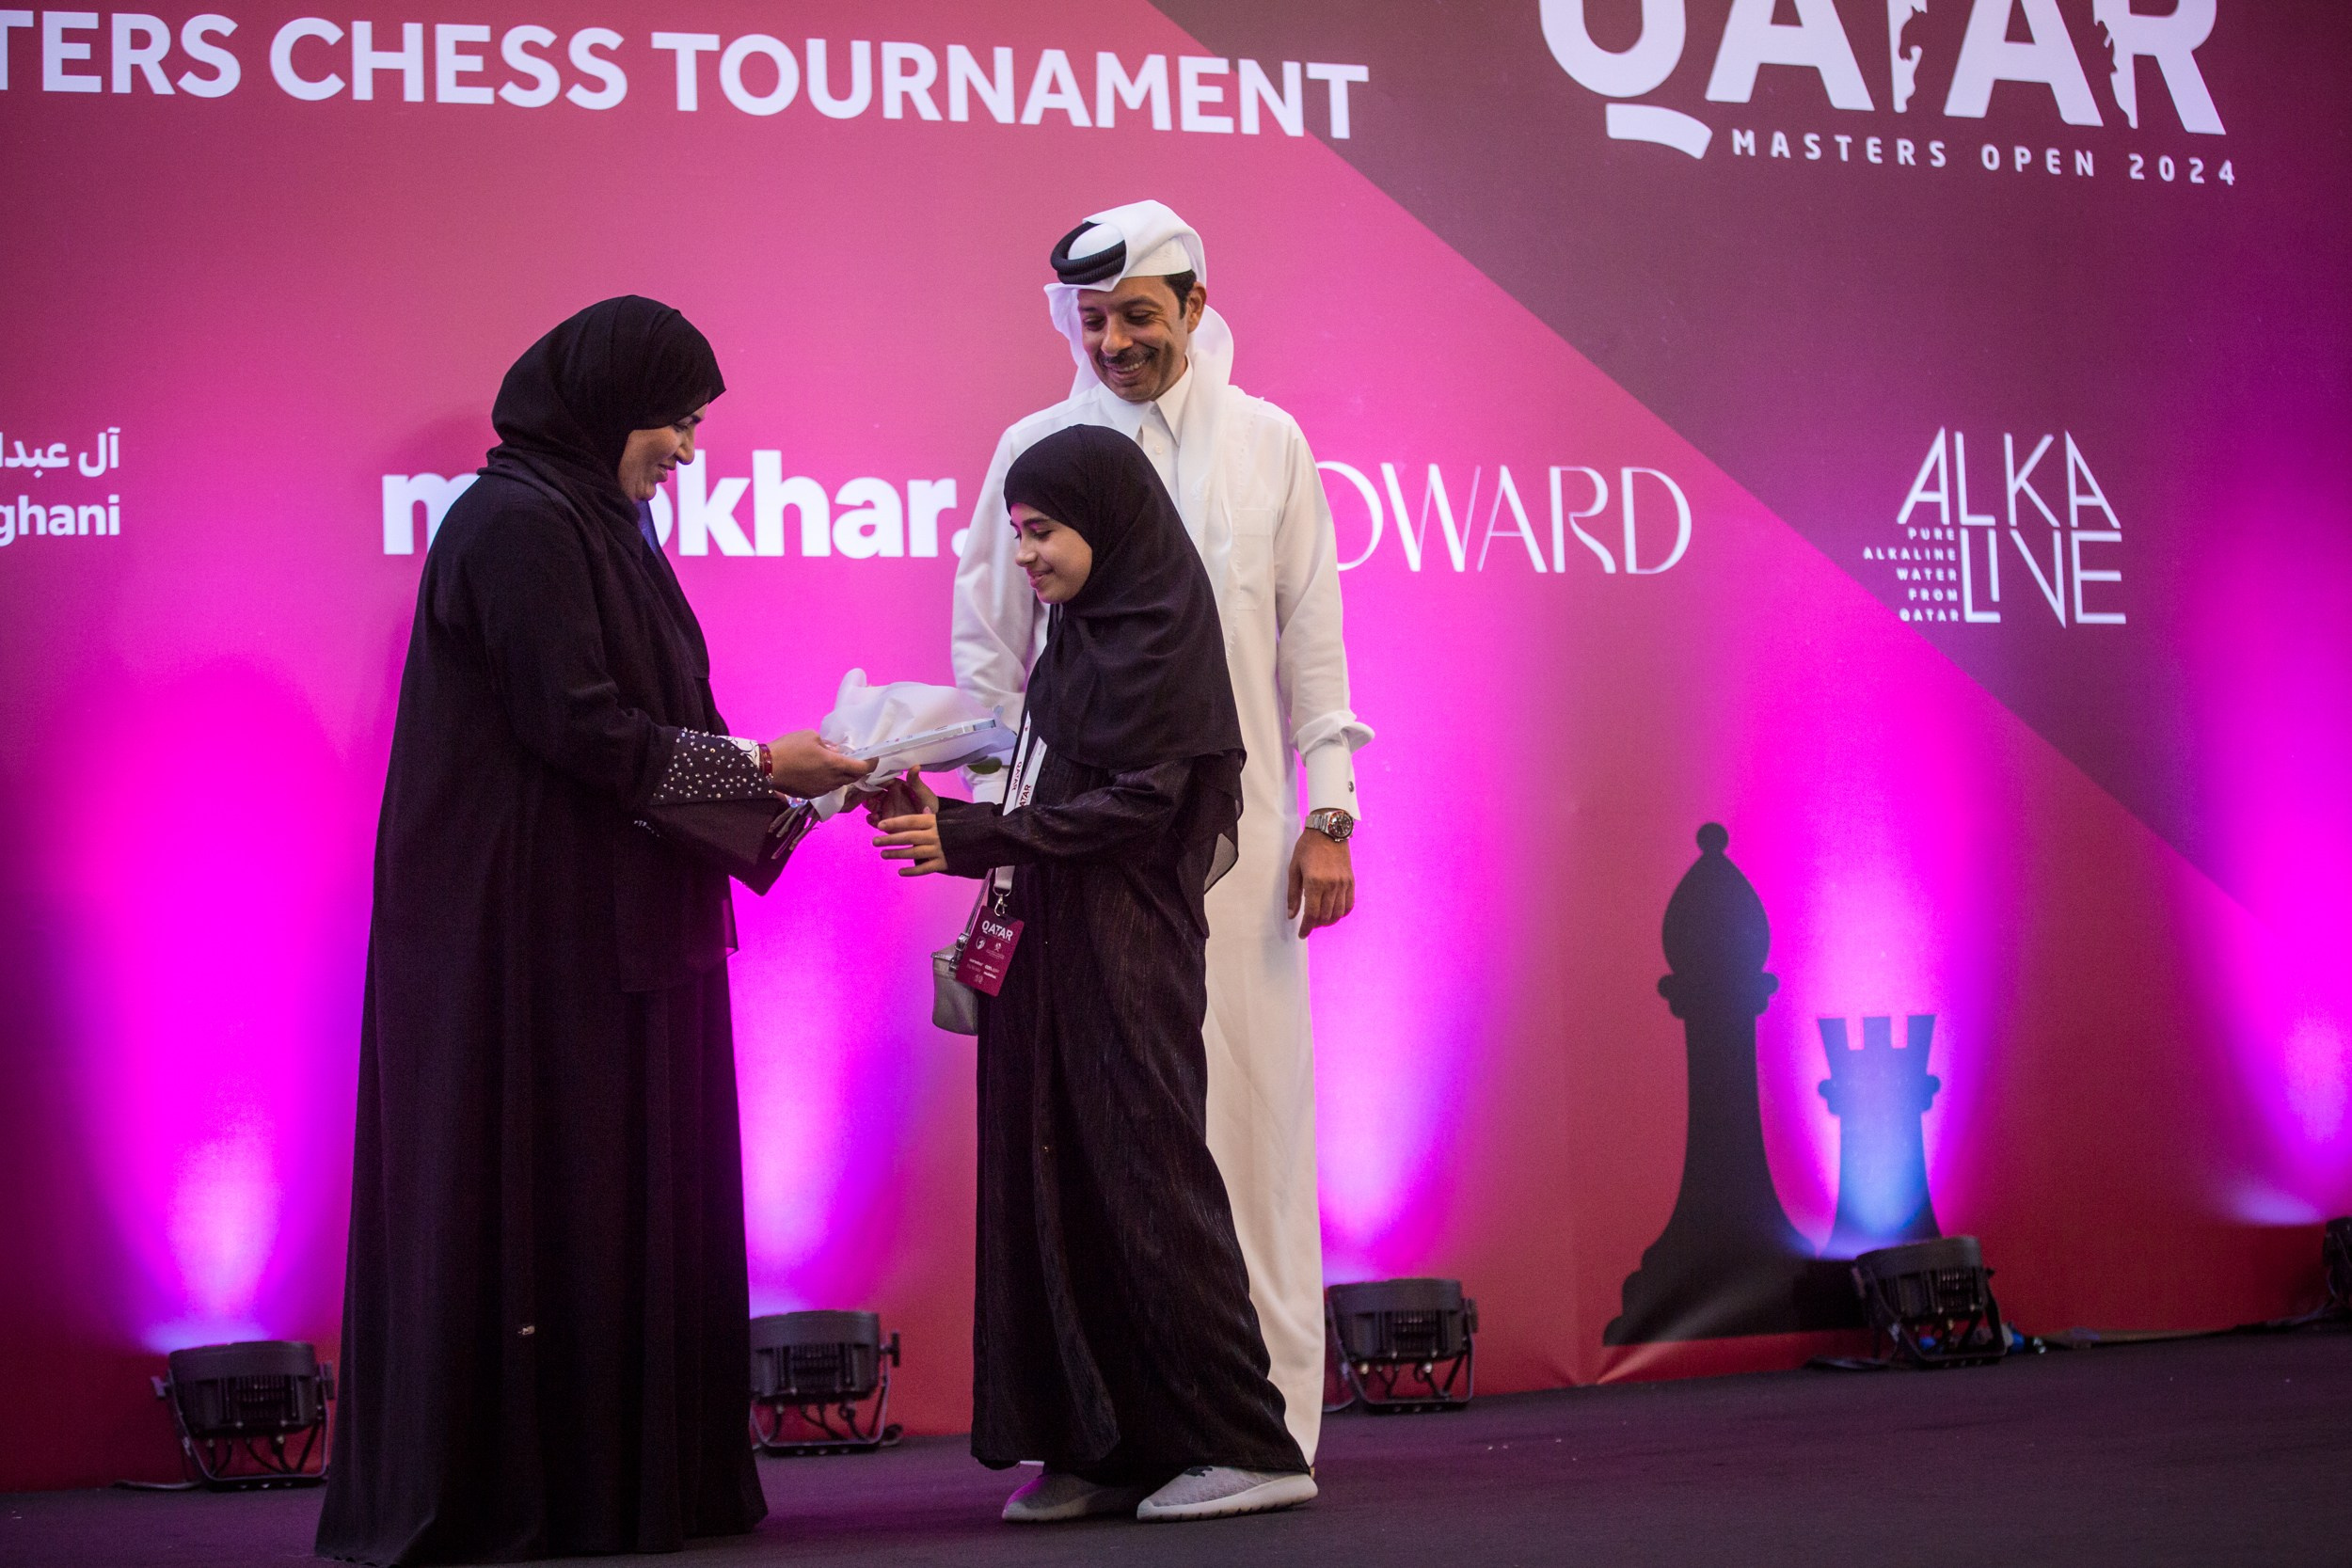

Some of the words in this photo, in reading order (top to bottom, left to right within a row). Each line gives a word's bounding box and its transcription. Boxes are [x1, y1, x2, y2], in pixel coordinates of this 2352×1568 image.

[269, 17, 628, 111] CHESS
[650, 31, 1370, 140] TOURNAMENT
[1731, 128, 1947, 168] MASTERS
[1980, 143, 2094, 177] OPEN
[2128, 153, 2235, 186] 2024
[78, 426, 121, 478] آل
[1896, 425, 2122, 529] ALKA
[1907, 526, 1955, 541] PURE
[1863, 546, 1957, 562] ALKALINE
[1896, 566, 1957, 581] WATER
[1908, 587, 1959, 602] FROM
[1899, 608, 1959, 623] QATAR
[981, 920, 1014, 942] QATAR
